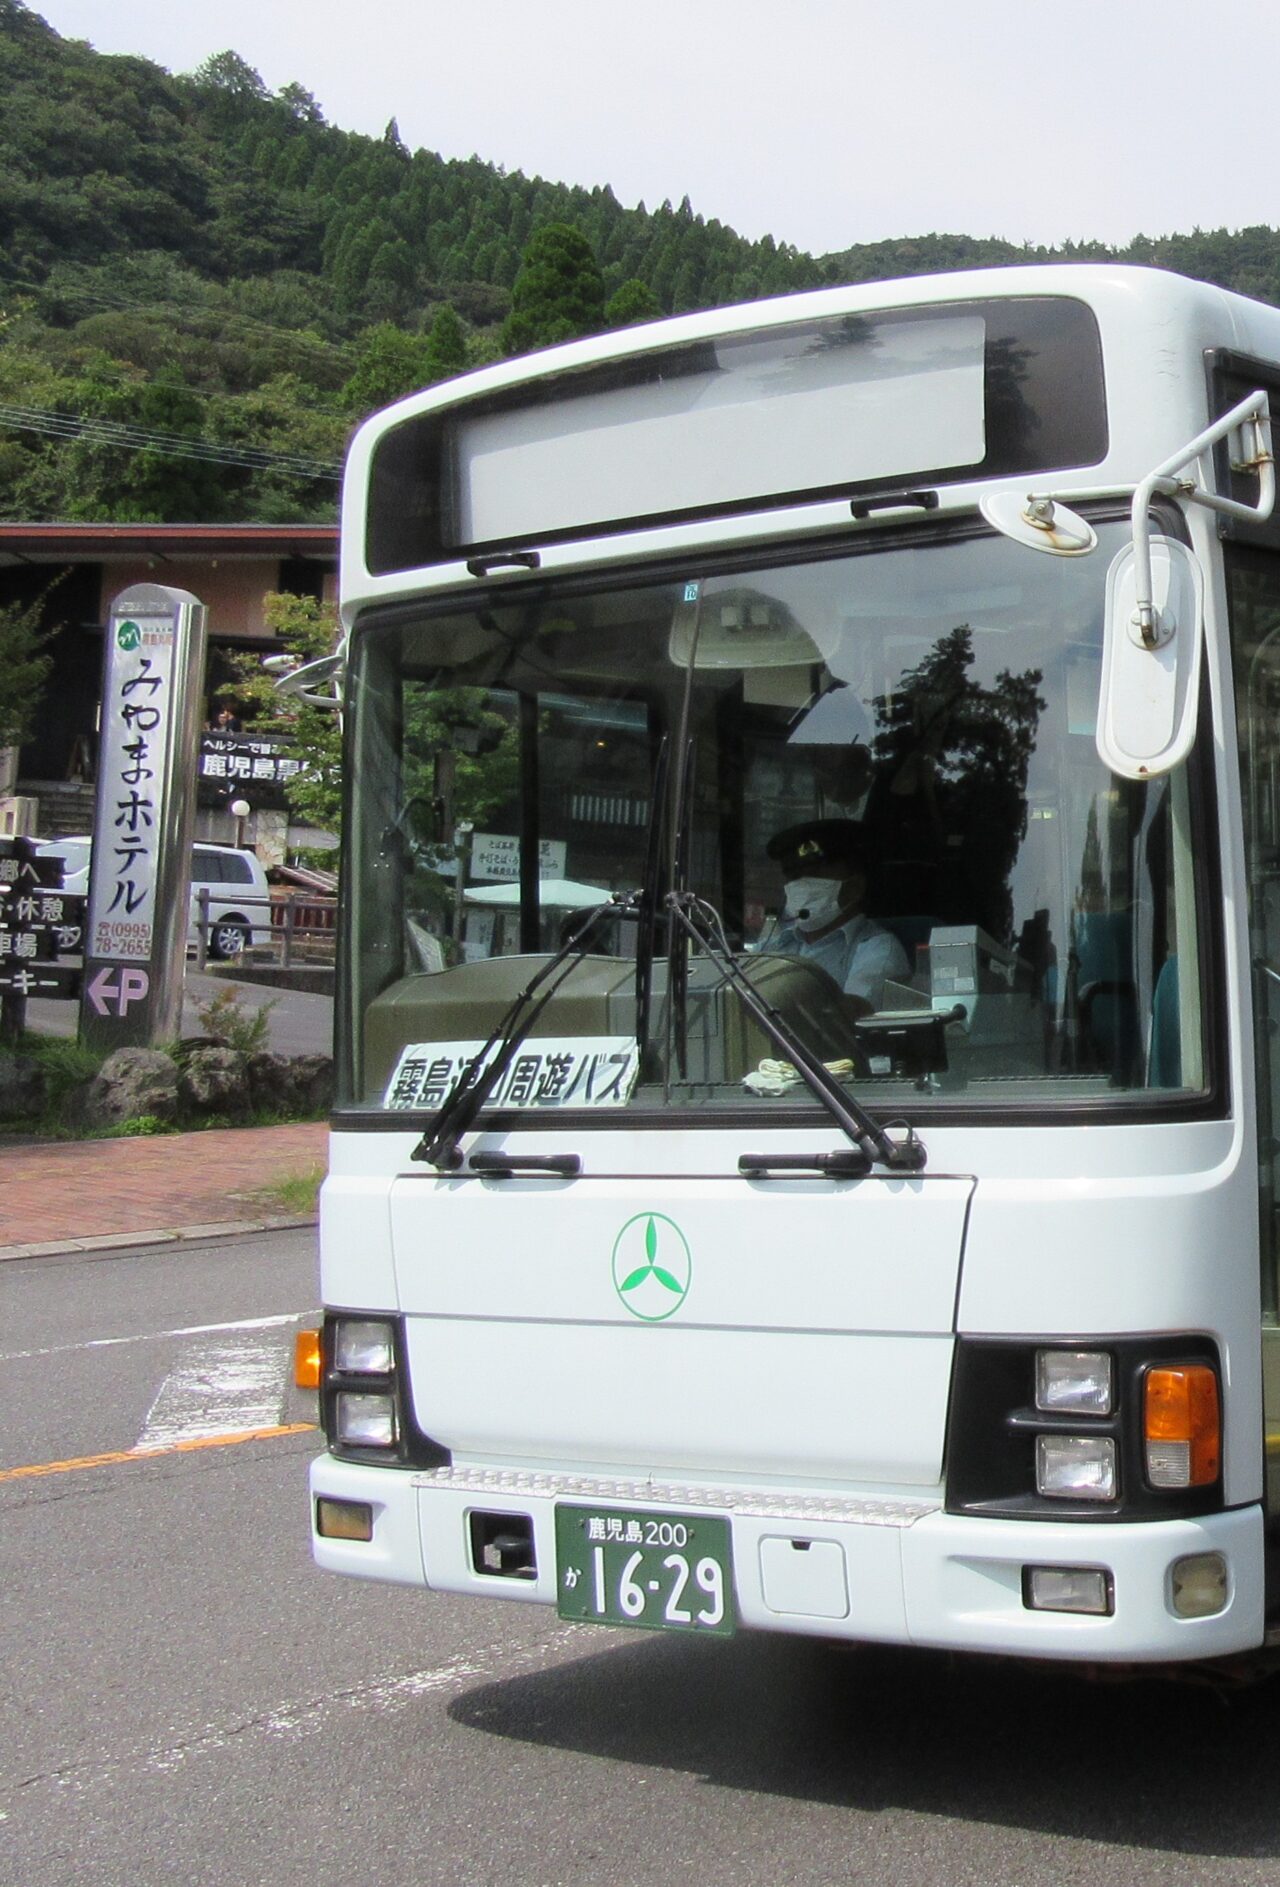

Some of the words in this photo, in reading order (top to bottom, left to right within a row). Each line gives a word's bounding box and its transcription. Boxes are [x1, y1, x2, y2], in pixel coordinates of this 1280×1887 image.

[202, 755, 342, 784] 鹿児島黒
[107, 658, 163, 914] みやまホテル
[0, 897, 64, 921] ・休憩
[119, 968, 149, 1016] P
[565, 1566, 582, 1588] か
